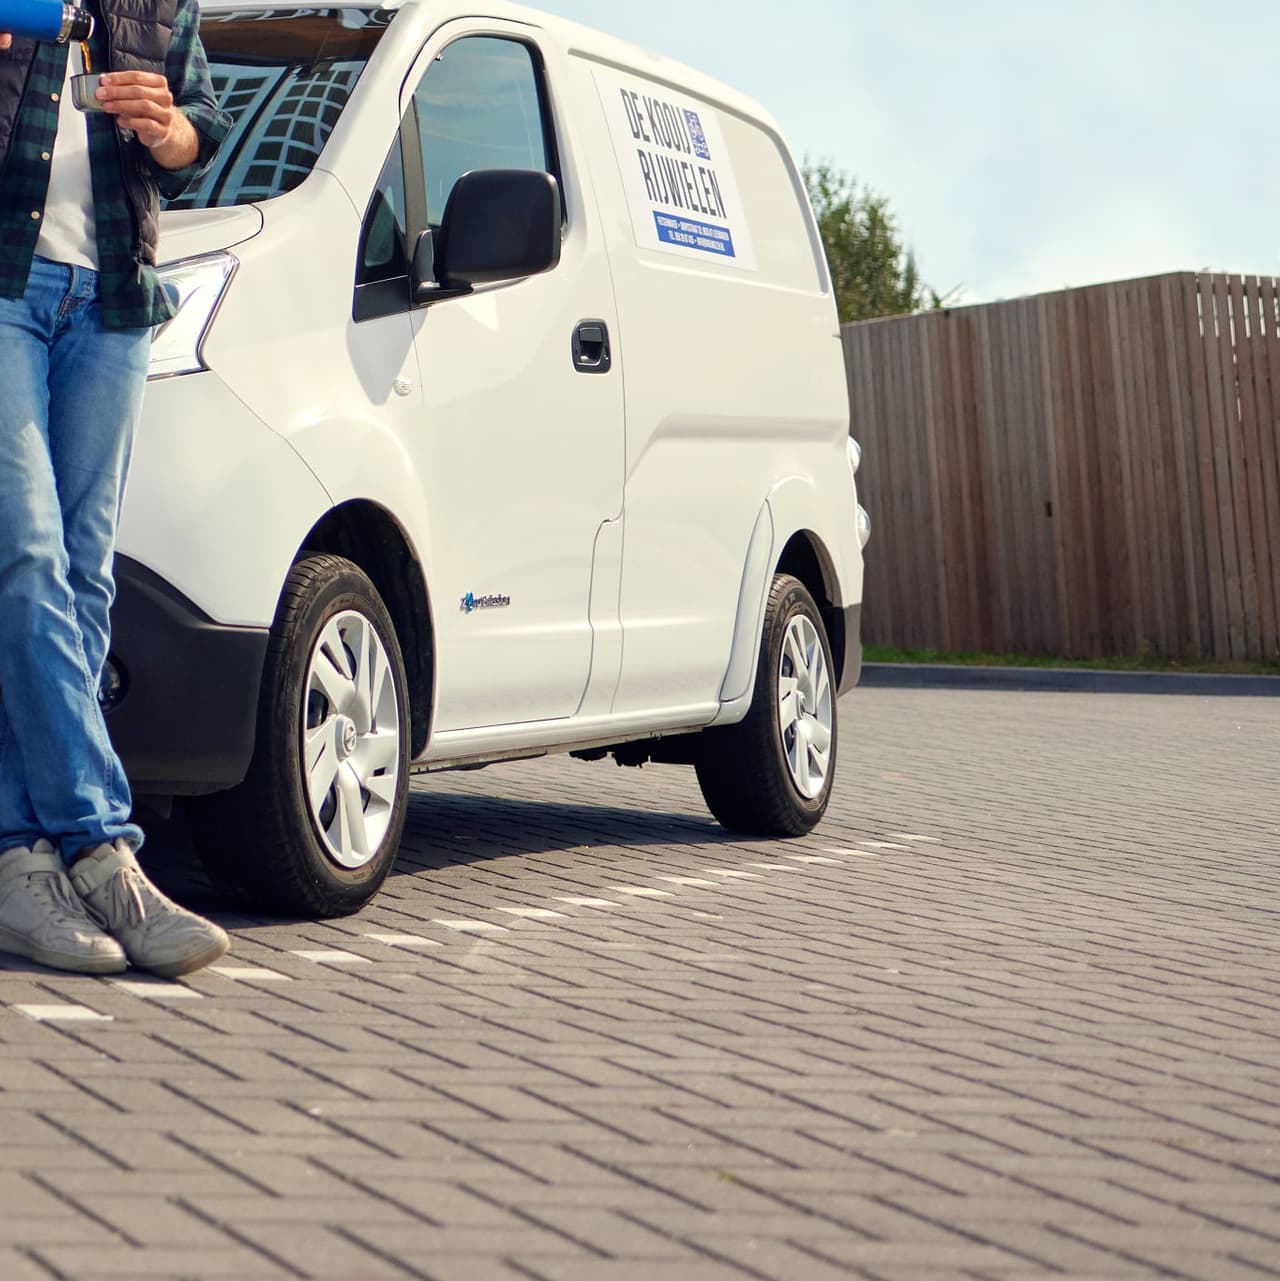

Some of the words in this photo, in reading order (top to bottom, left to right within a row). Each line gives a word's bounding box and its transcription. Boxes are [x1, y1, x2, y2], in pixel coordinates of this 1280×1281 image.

[619, 87, 651, 143] DE
[643, 95, 691, 155] KOOIJ
[637, 148, 727, 220] RIJWIELEN
